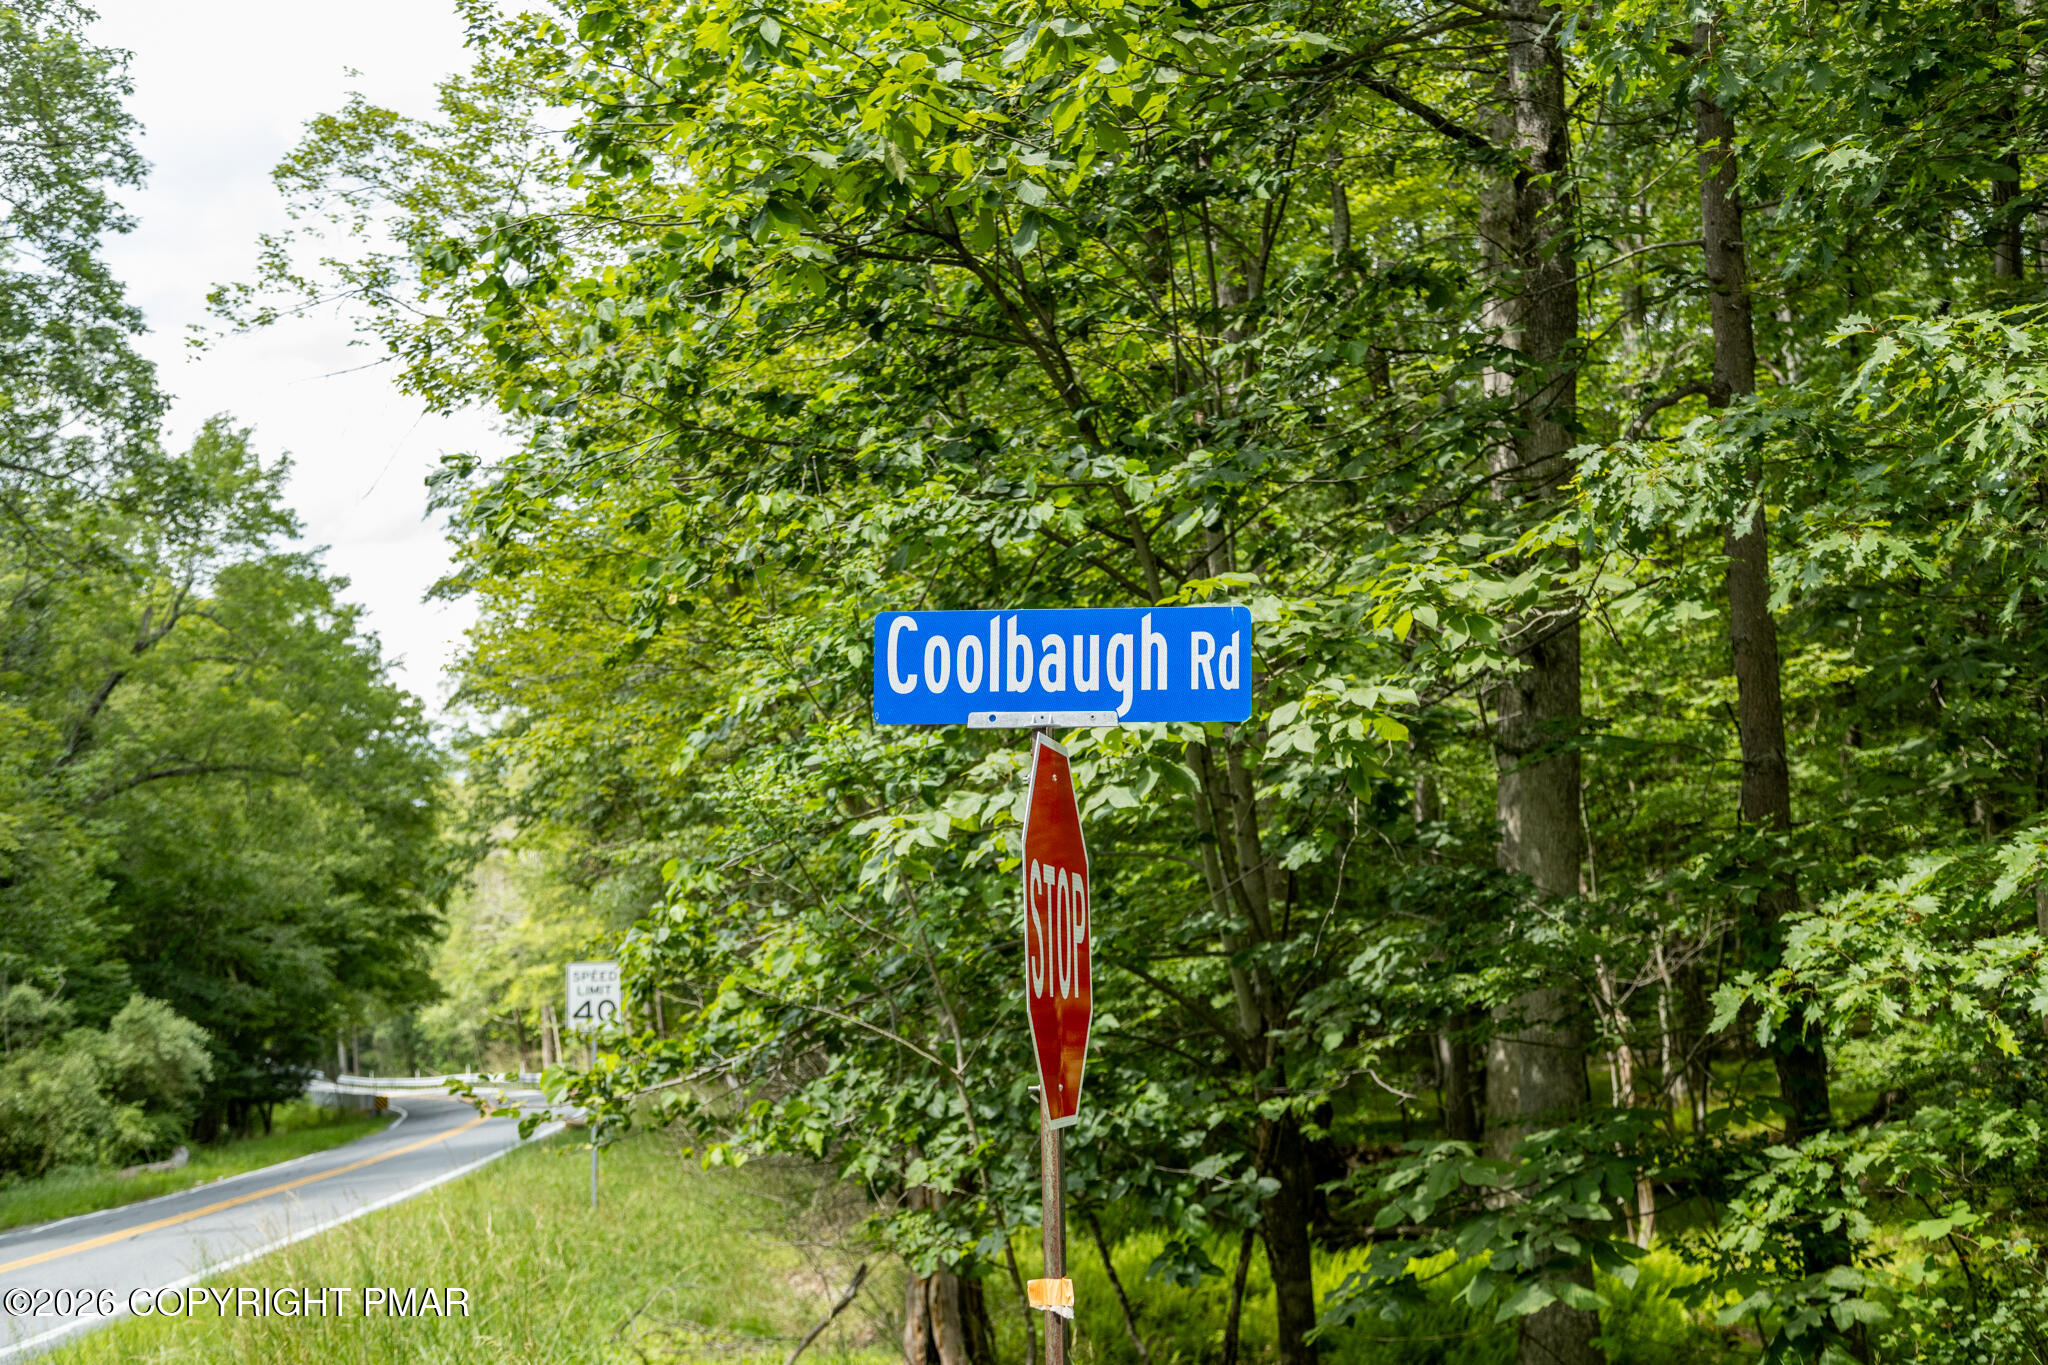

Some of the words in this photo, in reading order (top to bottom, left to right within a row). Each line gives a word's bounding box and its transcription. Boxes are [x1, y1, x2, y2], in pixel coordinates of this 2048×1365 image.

[887, 612, 1168, 718] Coolbaugh
[1190, 629, 1240, 690] Rd
[1031, 858, 1086, 1000] STOP
[573, 969, 617, 982] SPEED
[576, 985, 612, 997] LIMIT
[573, 999, 617, 1022] 40
